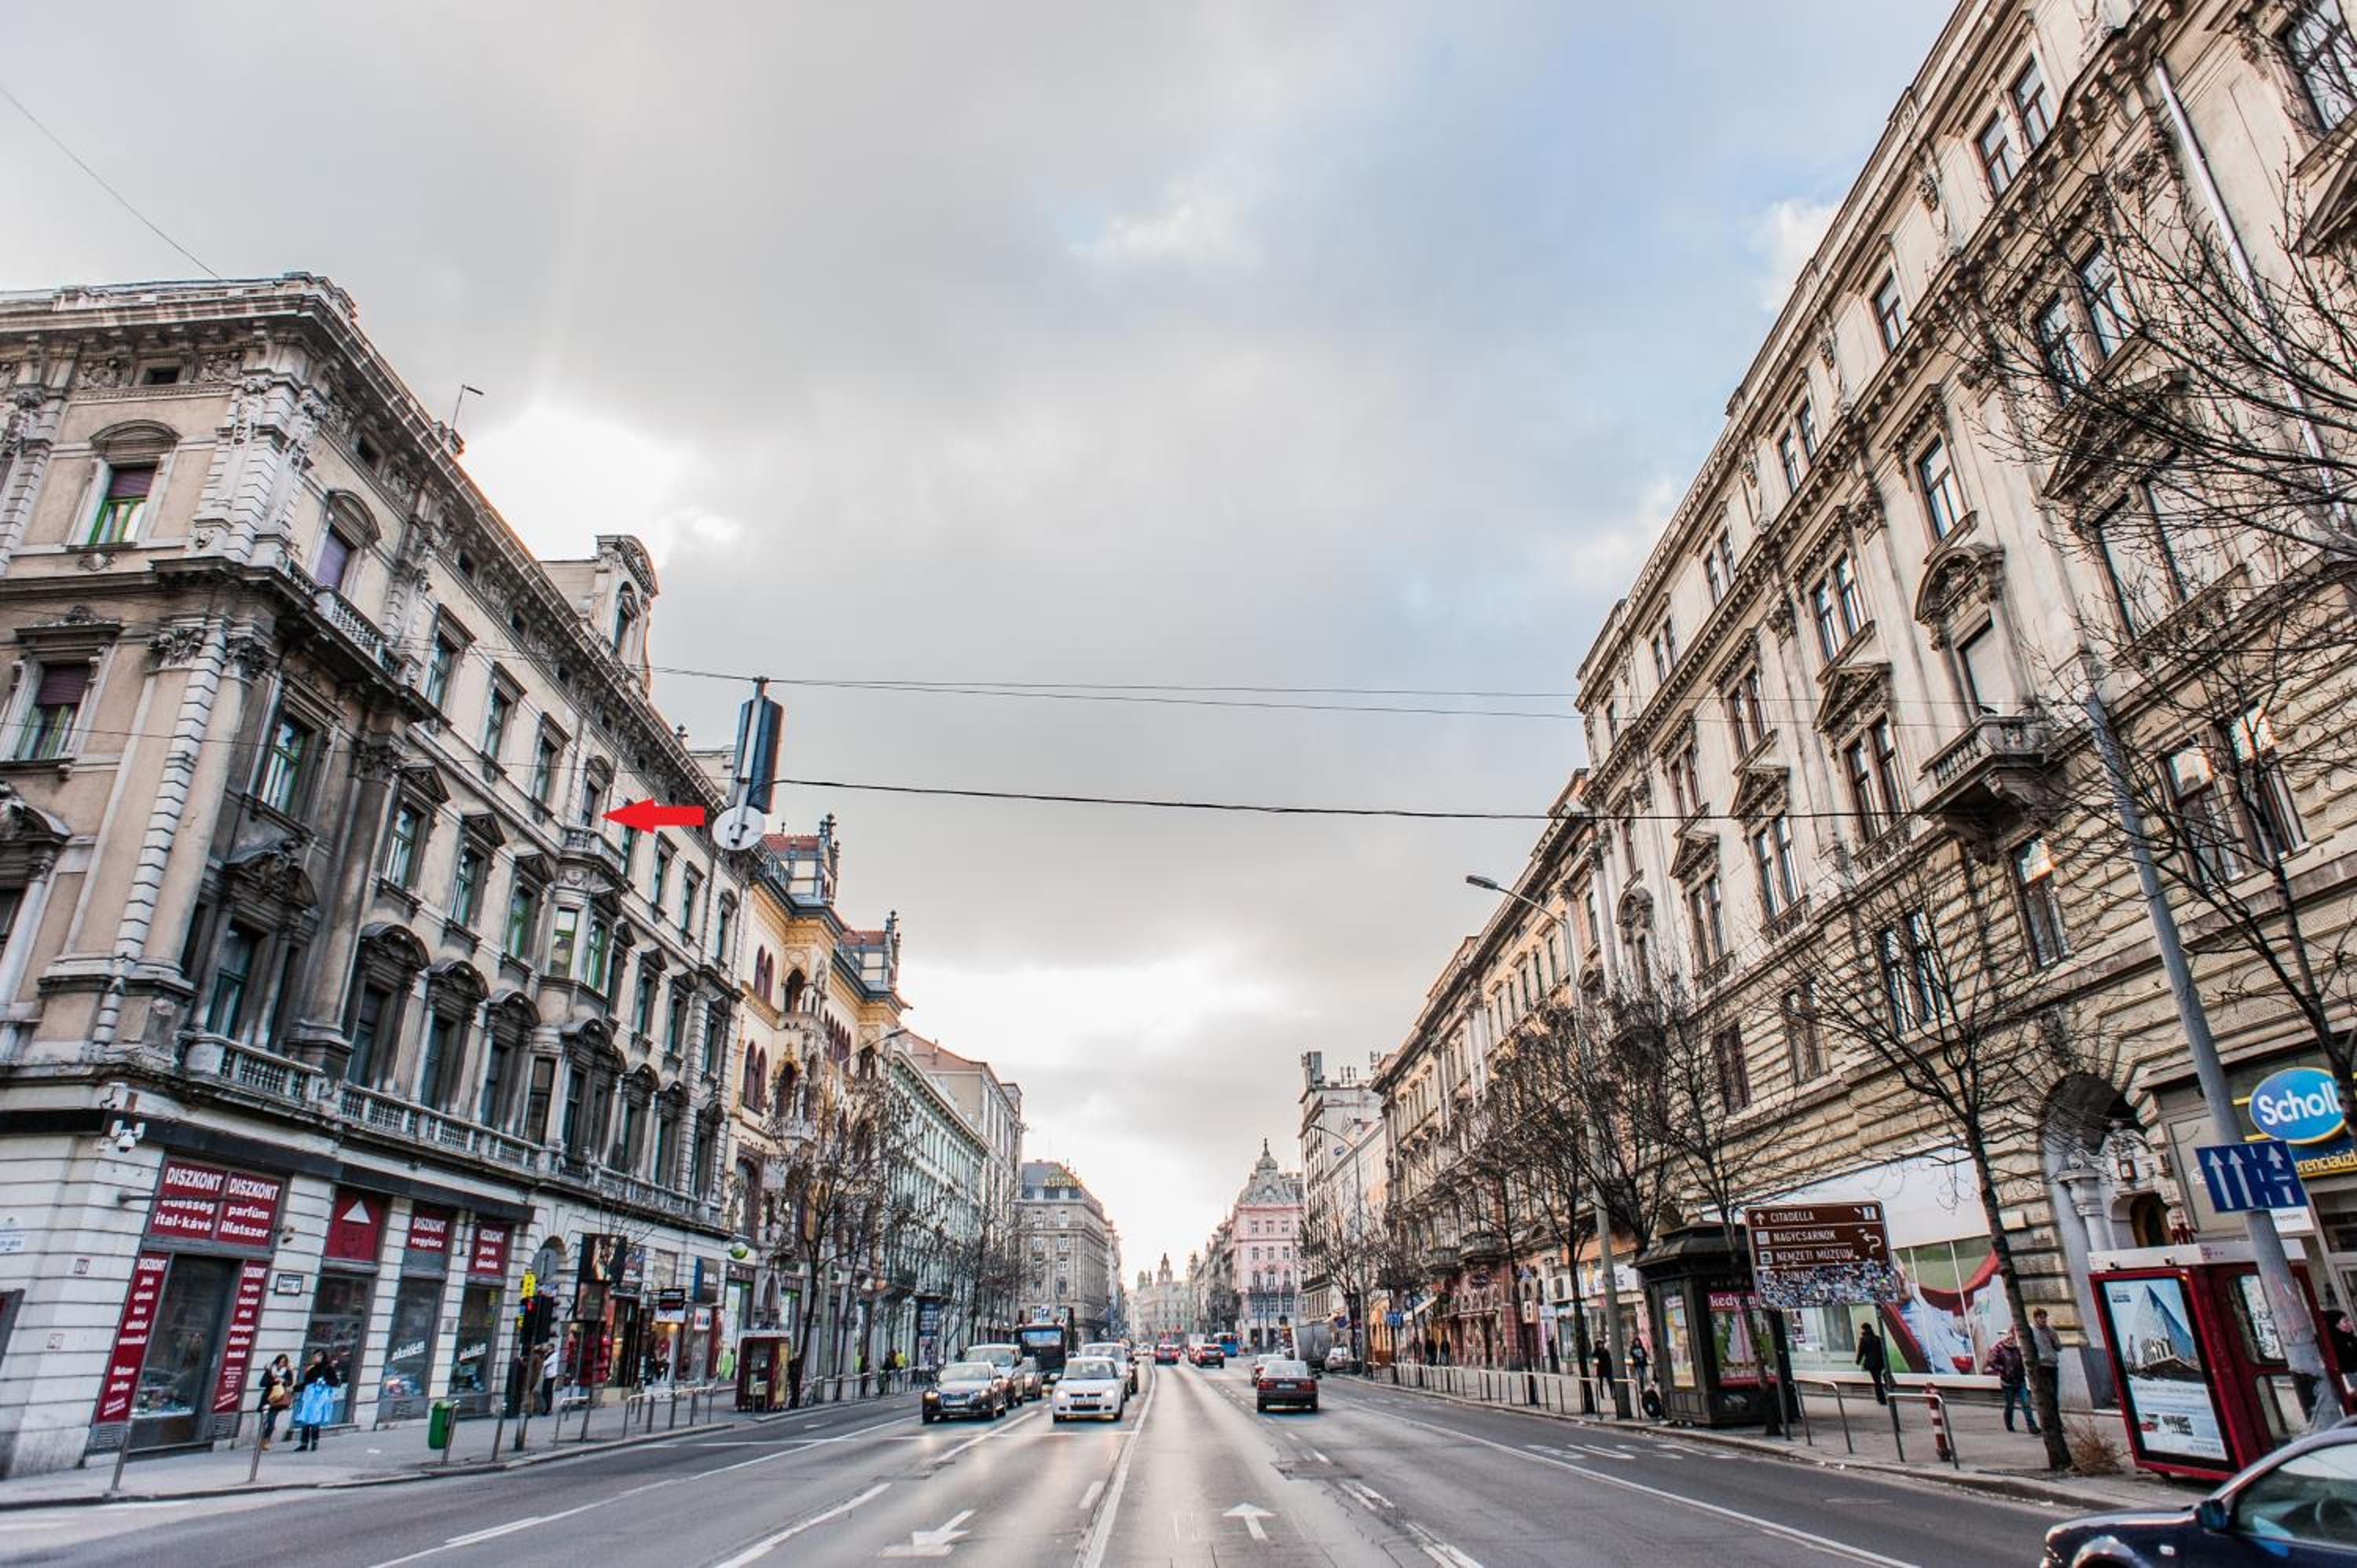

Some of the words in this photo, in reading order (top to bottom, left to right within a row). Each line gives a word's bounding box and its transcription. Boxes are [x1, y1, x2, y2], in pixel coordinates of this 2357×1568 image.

[2257, 1081, 2343, 1126] Scholl
[165, 1167, 224, 1191] DISZKONT
[229, 1178, 280, 1200] DISZKONT
[1770, 1211, 1815, 1223] CITADELLA
[1773, 1229, 1836, 1243] NAGYCSARNOK
[1776, 1249, 1814, 1262] NEMZETI
